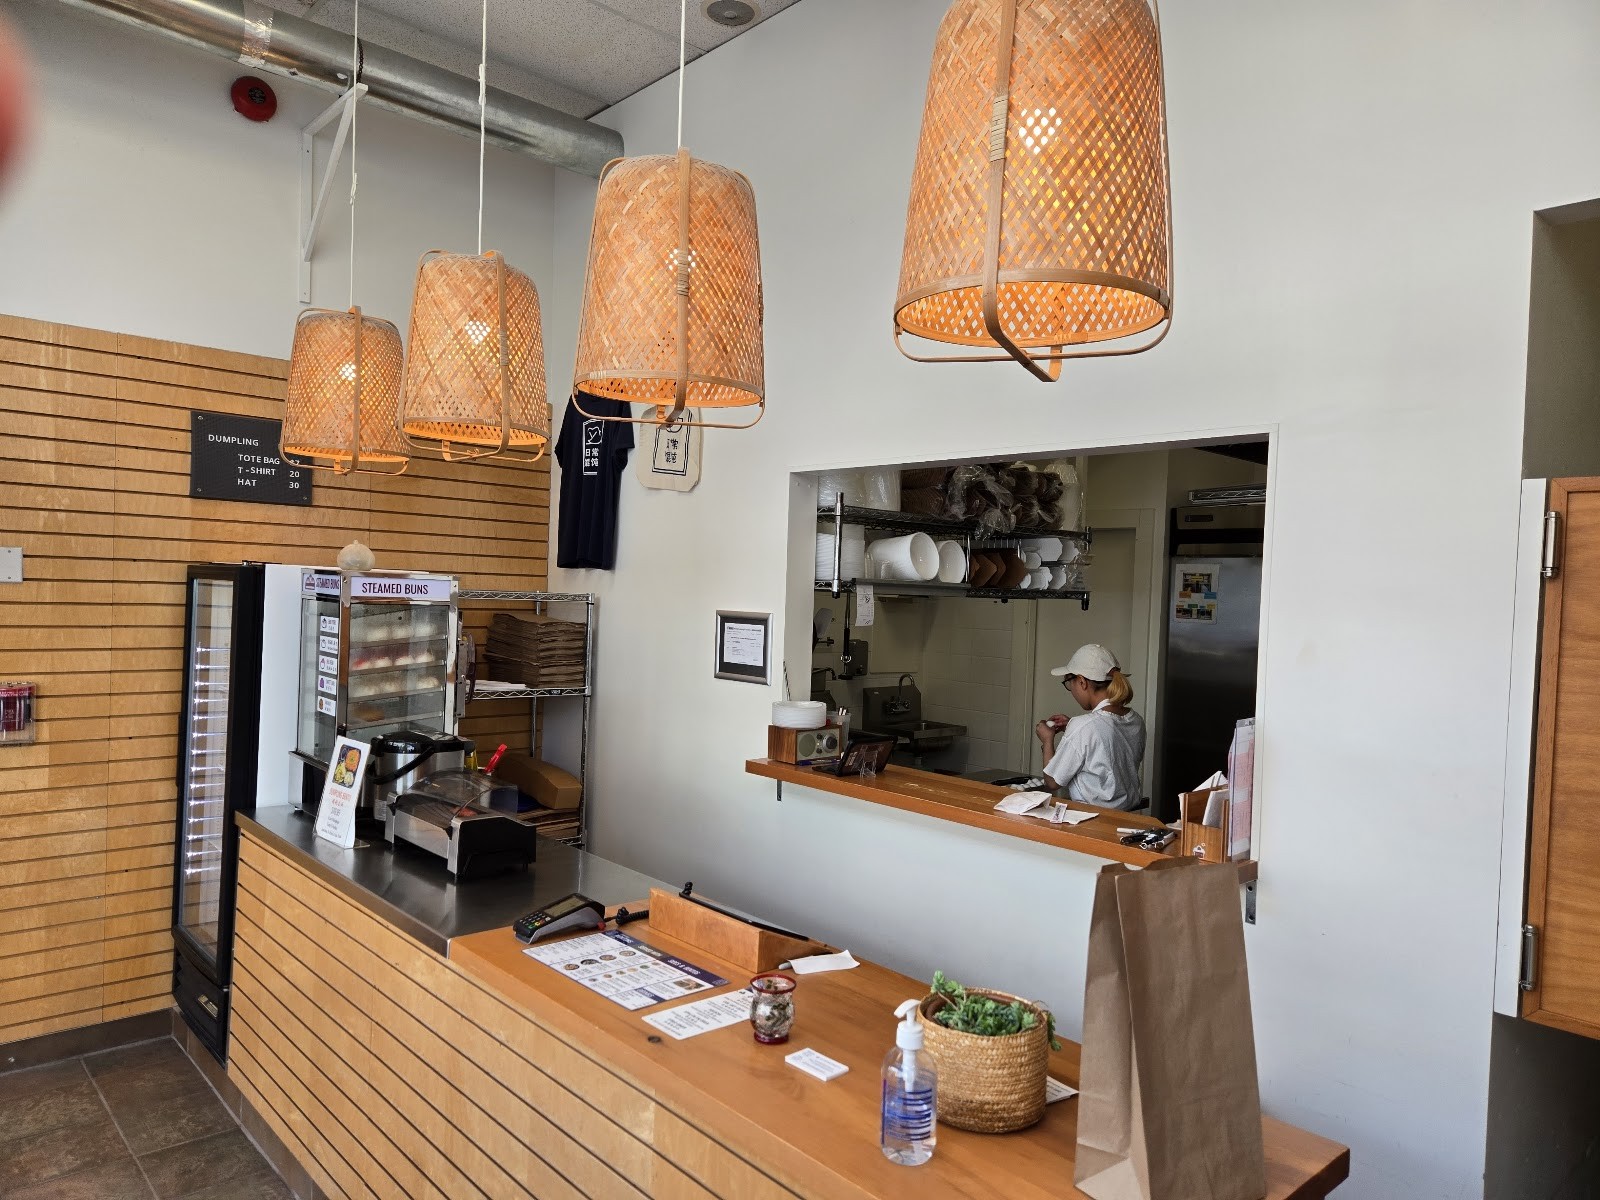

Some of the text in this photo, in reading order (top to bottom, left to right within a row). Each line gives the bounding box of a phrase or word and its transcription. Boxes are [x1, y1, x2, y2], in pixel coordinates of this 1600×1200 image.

[208, 434, 259, 447] DUMPLING
[238, 454, 262, 463] TOTE
[263, 456, 280, 465] BAG
[289, 470, 300, 479] 20
[237, 478, 300, 489] HAT 30
[362, 582, 429, 595] STEAMED BUNS
